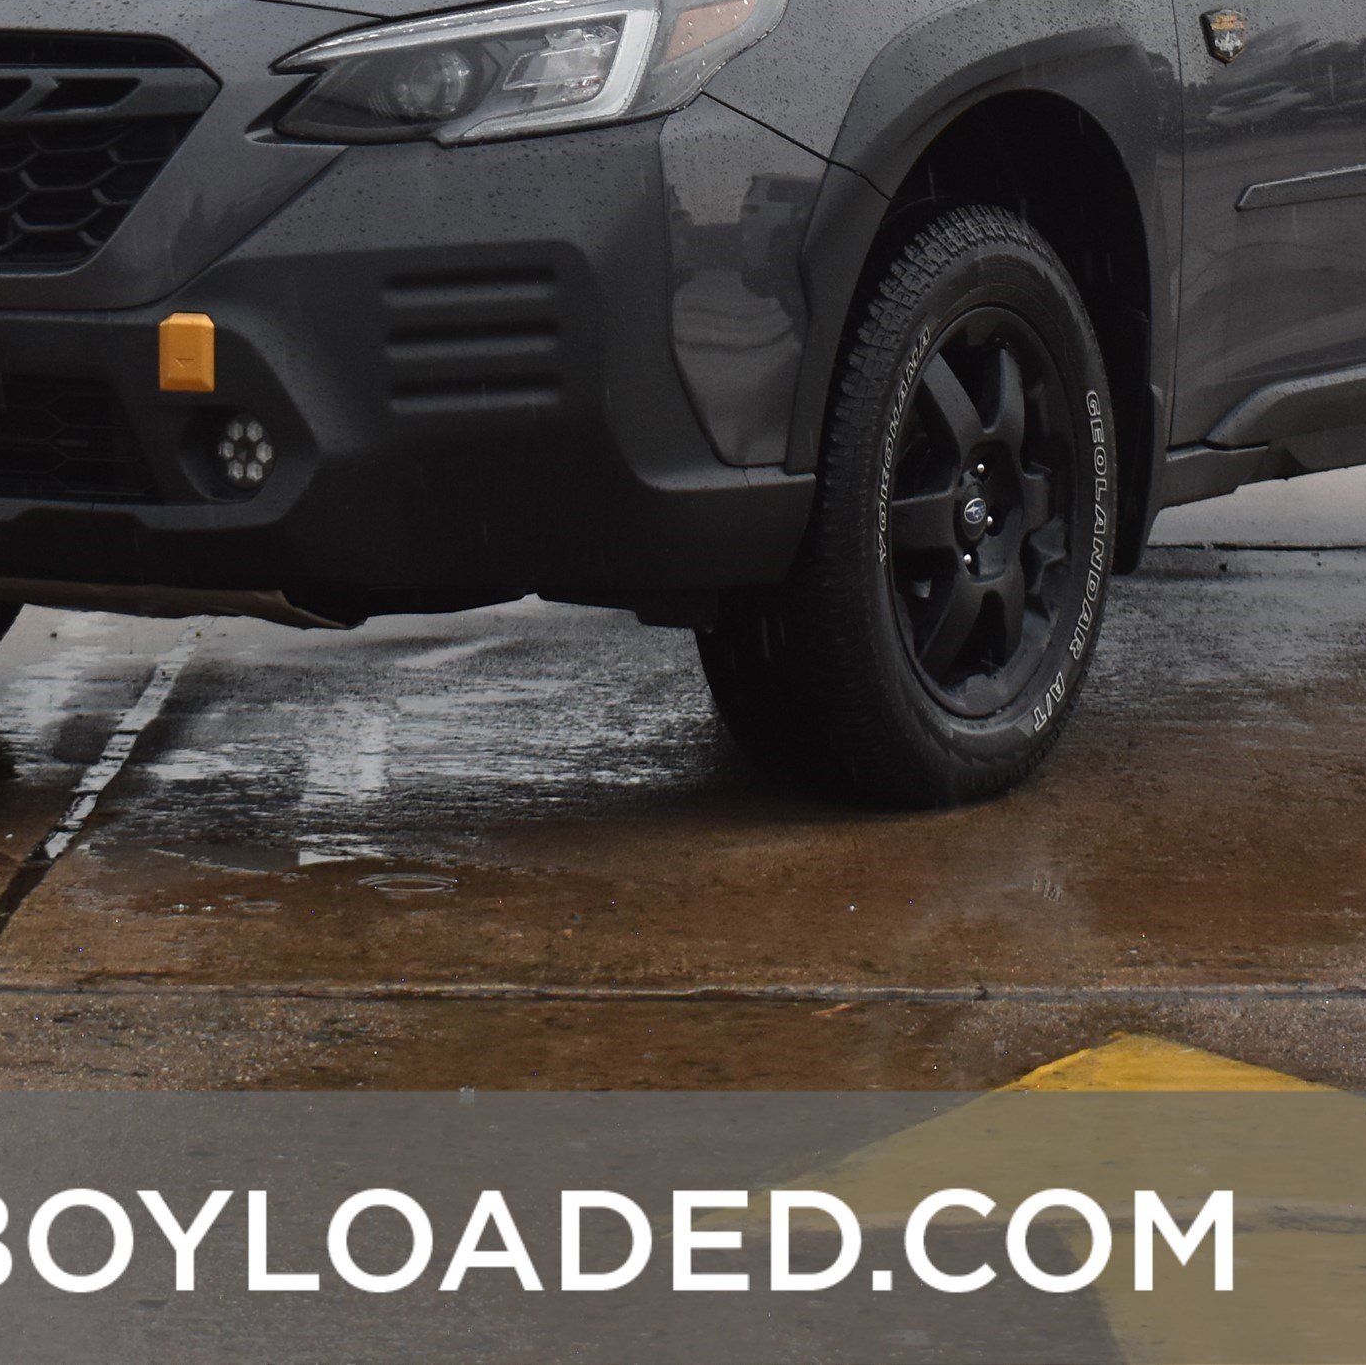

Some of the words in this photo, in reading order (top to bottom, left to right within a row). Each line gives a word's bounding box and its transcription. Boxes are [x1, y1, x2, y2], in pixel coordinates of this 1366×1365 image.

[875, 326, 932, 565] YOKOHAMA
[1068, 389, 1108, 661] GEOLANDAR
[1031, 668, 1067, 733] A/T
